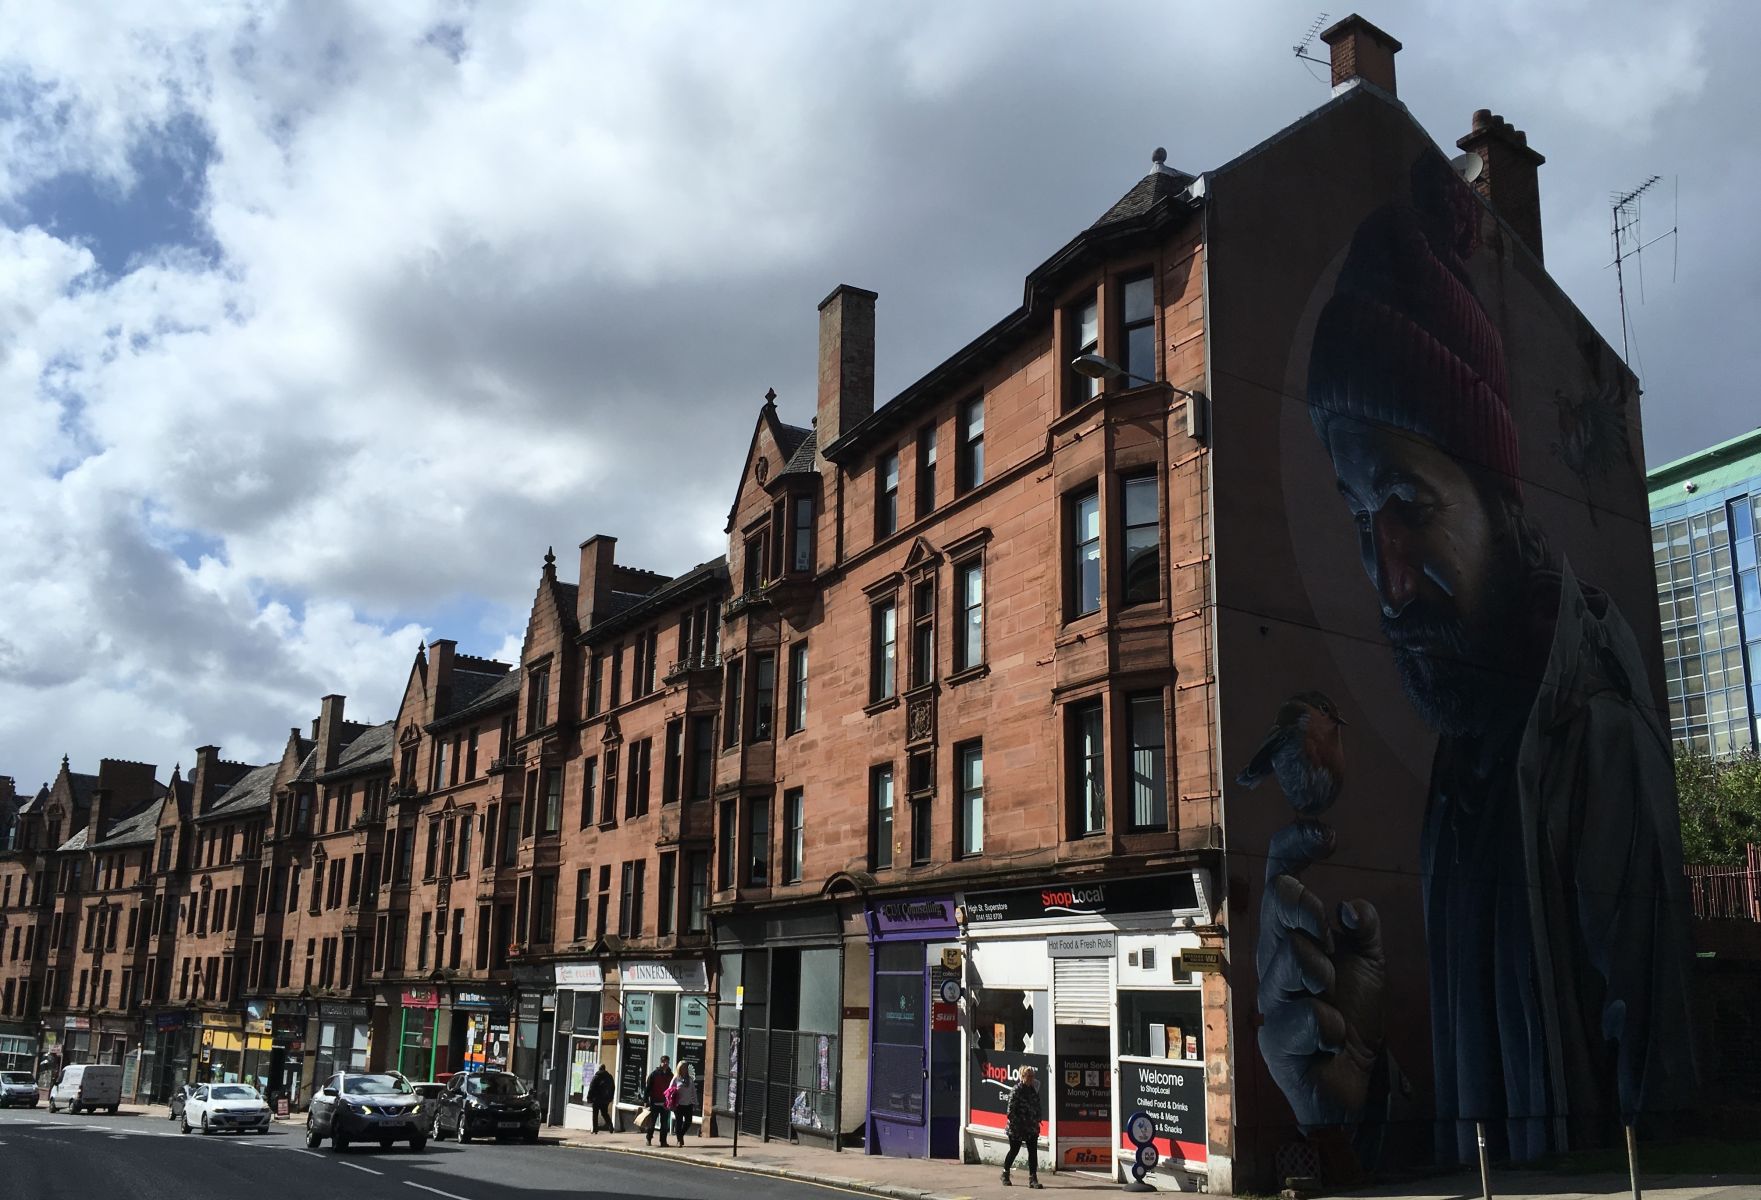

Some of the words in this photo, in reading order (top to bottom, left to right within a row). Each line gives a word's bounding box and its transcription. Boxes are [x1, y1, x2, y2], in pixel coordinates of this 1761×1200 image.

[1042, 885, 1104, 907] ShopLocal
[968, 904, 978, 914] High
[984, 902, 1008, 913] Superstore
[1048, 940, 1059, 950] Hot
[1060, 940, 1074, 950] Food
[1075, 940, 1079, 949] &
[1080, 939, 1097, 949] Fresh
[1098, 938, 1112, 948] Rolls
[1064, 1060, 1088, 1069] Instore
[1138, 1068, 1184, 1087] Welcome
[1067, 1088, 1089, 1098] Money
[1145, 1085, 1171, 1095] ShopLocal
[1136, 1097, 1154, 1107] Chilled
[1153, 1099, 1167, 1108] Food
[1167, 1101, 1172, 1109] &
[1172, 1101, 1189, 1111] Drinks
[1160, 1112, 1165, 1120] &
[1165, 1112, 1179, 1123] Mags
[1164, 1123, 1183, 1134] Snacks
